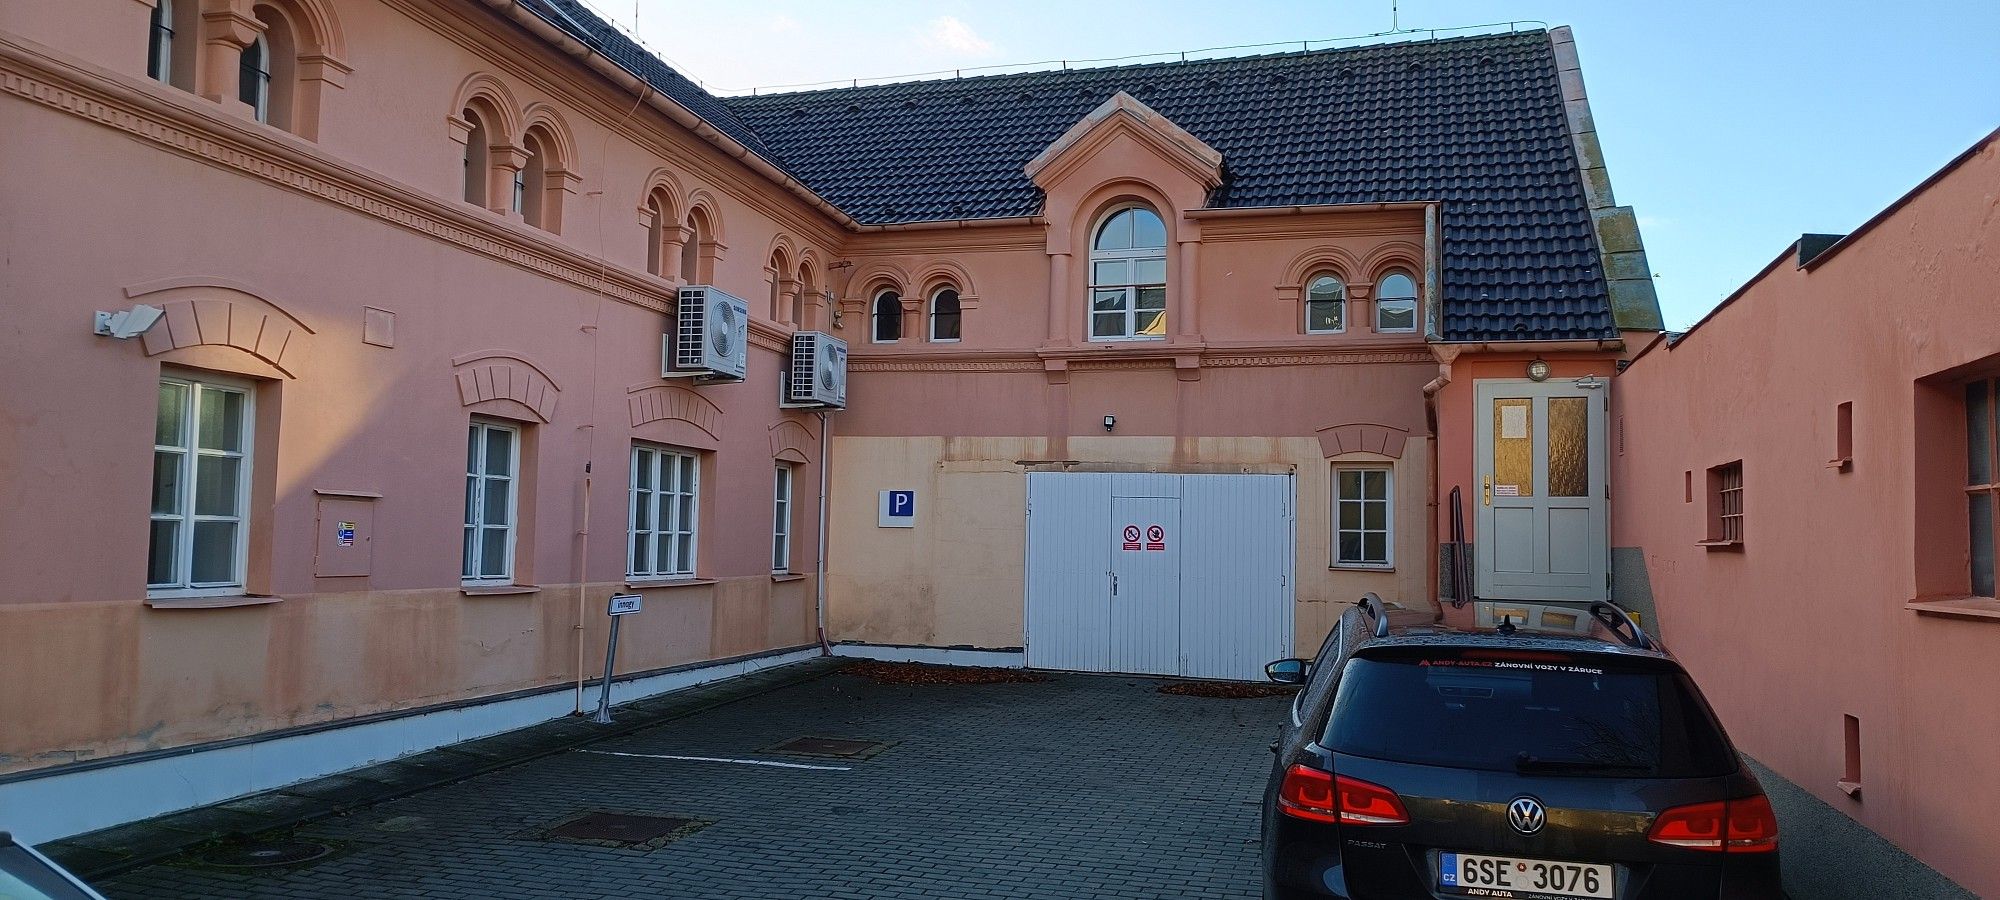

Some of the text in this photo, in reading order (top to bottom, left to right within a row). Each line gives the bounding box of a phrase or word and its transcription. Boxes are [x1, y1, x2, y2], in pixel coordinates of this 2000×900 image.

[895, 493, 908, 513] P
[1567, 666, 1603, 675] ZÁRUCE
[1347, 839, 1387, 849] PASSAT
[1443, 873, 1456, 882] CZ
[1463, 858, 1600, 894] 6SE 3076
[1467, 888, 1513, 898] ANDY AUTA
